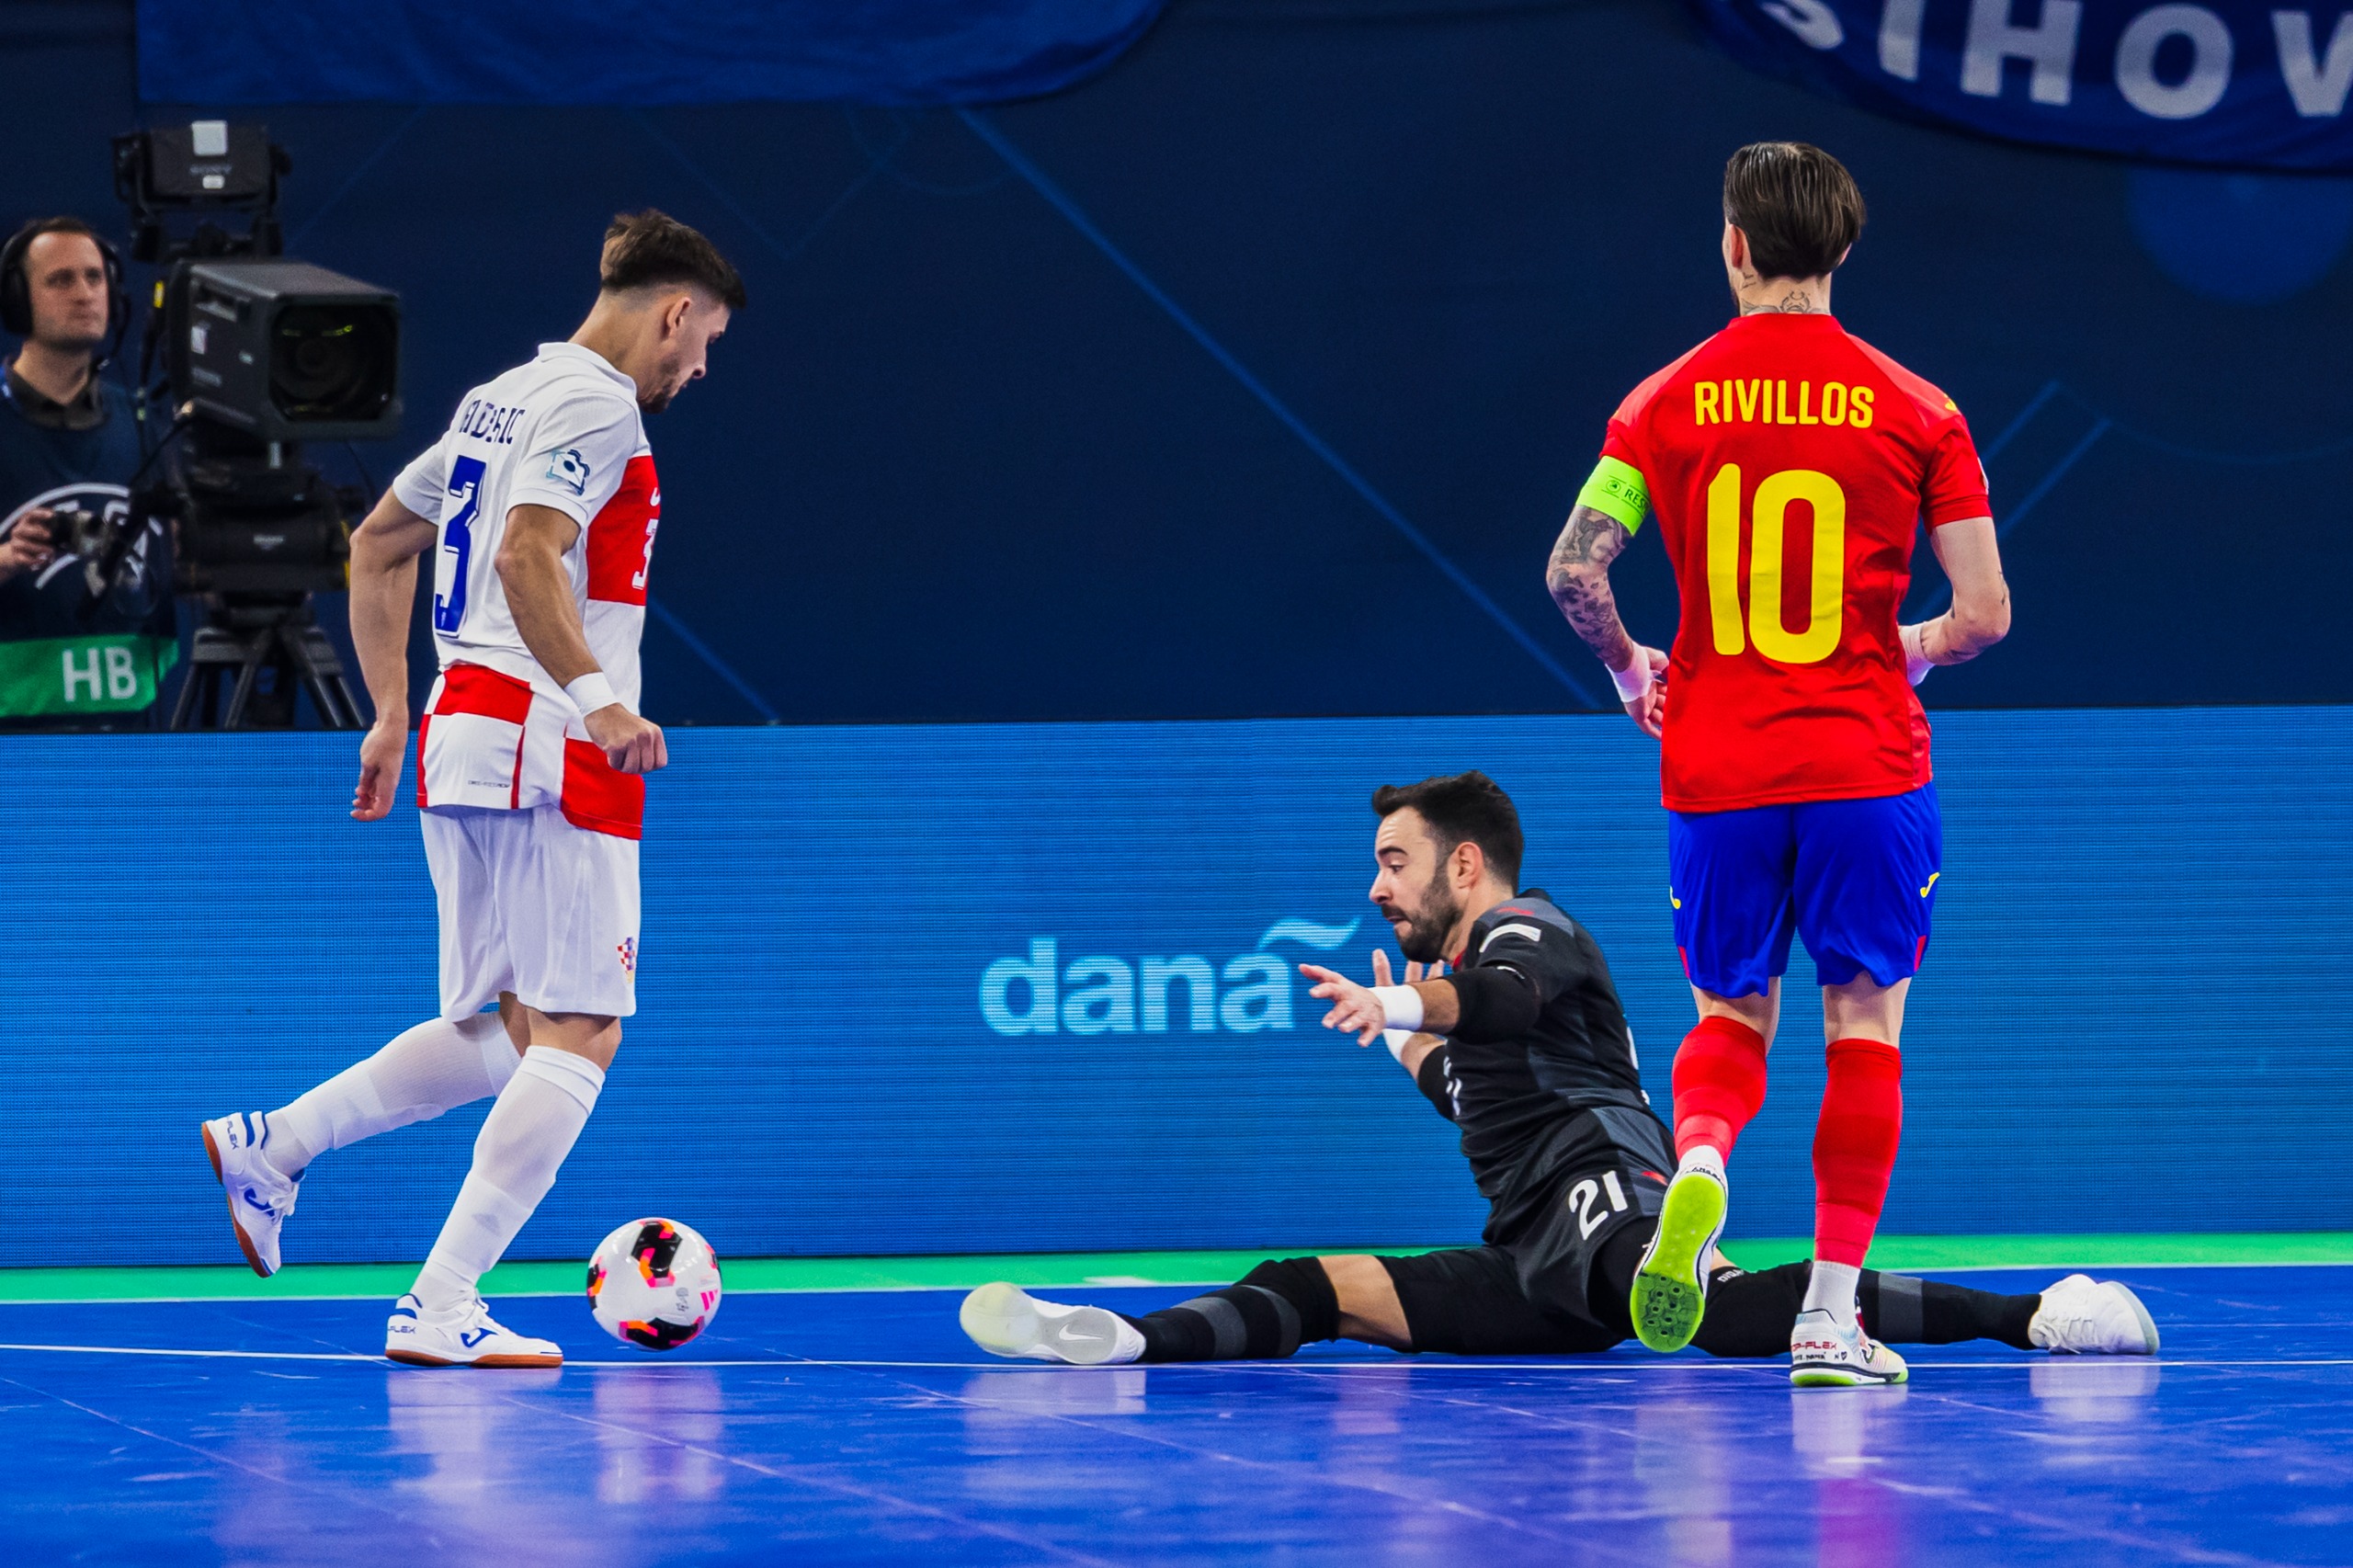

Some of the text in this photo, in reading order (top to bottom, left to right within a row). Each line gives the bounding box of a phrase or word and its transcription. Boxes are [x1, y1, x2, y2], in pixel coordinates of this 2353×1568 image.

[1694, 378, 1875, 429] RIVILLOS
[432, 454, 486, 639] 3
[1707, 462, 1847, 665] 10
[62, 646, 137, 702] HB
[1568, 1169, 1629, 1241] 21
